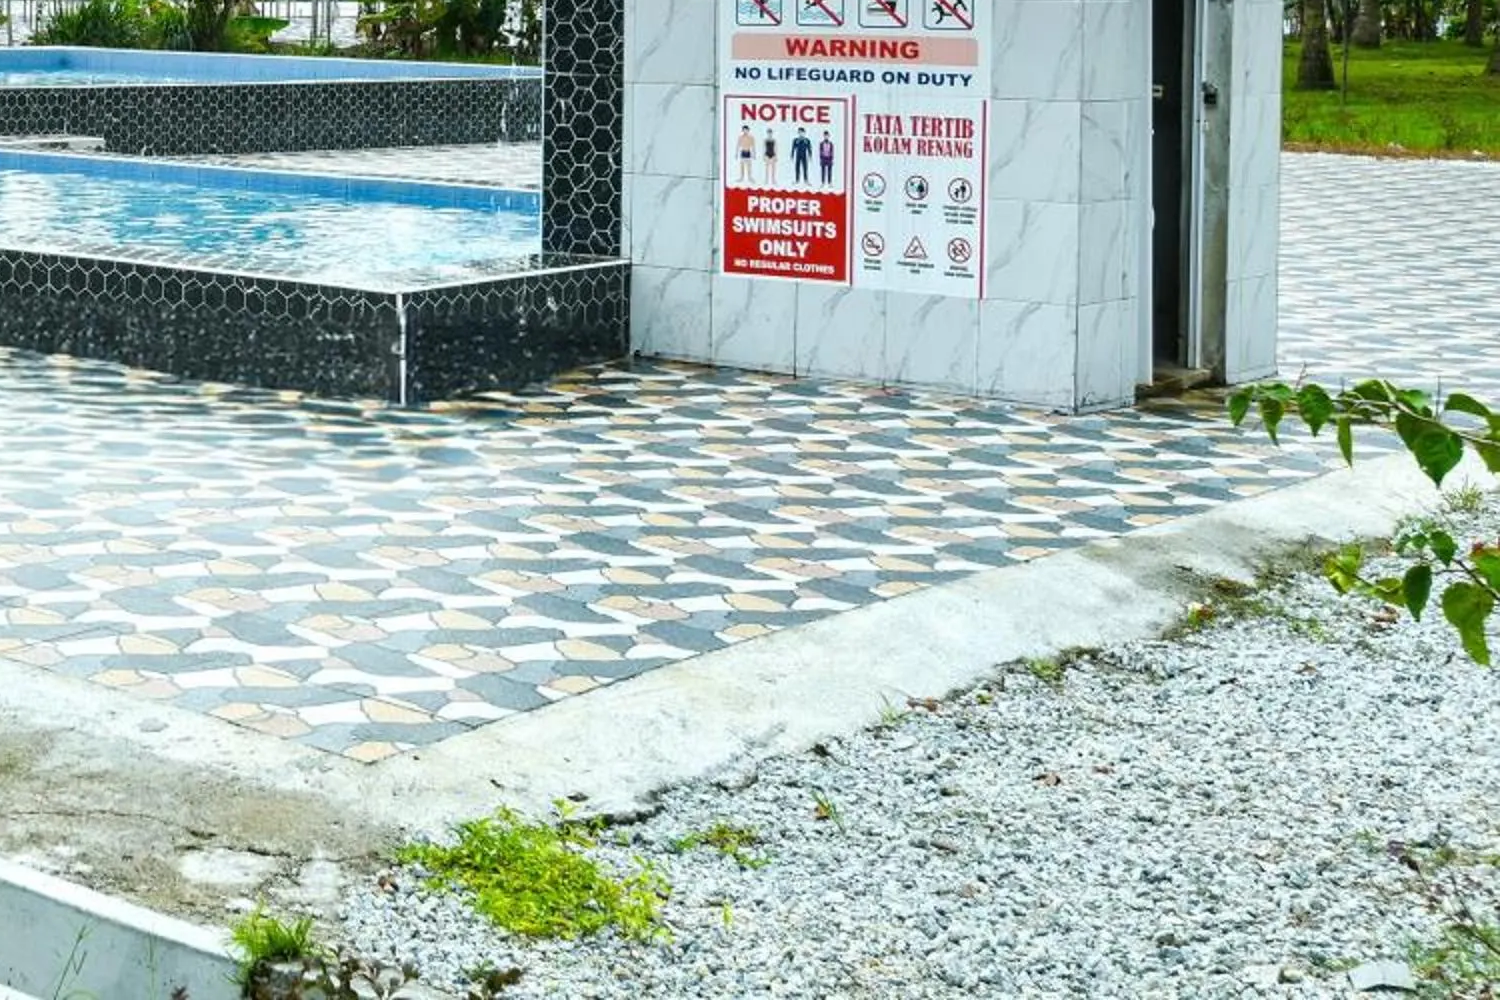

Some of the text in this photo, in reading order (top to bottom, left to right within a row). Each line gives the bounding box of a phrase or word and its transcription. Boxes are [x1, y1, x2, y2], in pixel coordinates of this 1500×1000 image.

[786, 37, 920, 60] WARNING
[735, 67, 973, 87] NO LIFEGUARD ON DUTY
[740, 103, 831, 124] NOTICE
[863, 113, 975, 139] TATA TERTIB
[863, 138, 974, 159] KOLAM RENANG
[747, 195, 821, 216] PROPER
[732, 216, 837, 239] SWIMSUITS
[759, 239, 809, 258] ONLY
[734, 260, 835, 275] NO REGULAR CLOTHES
